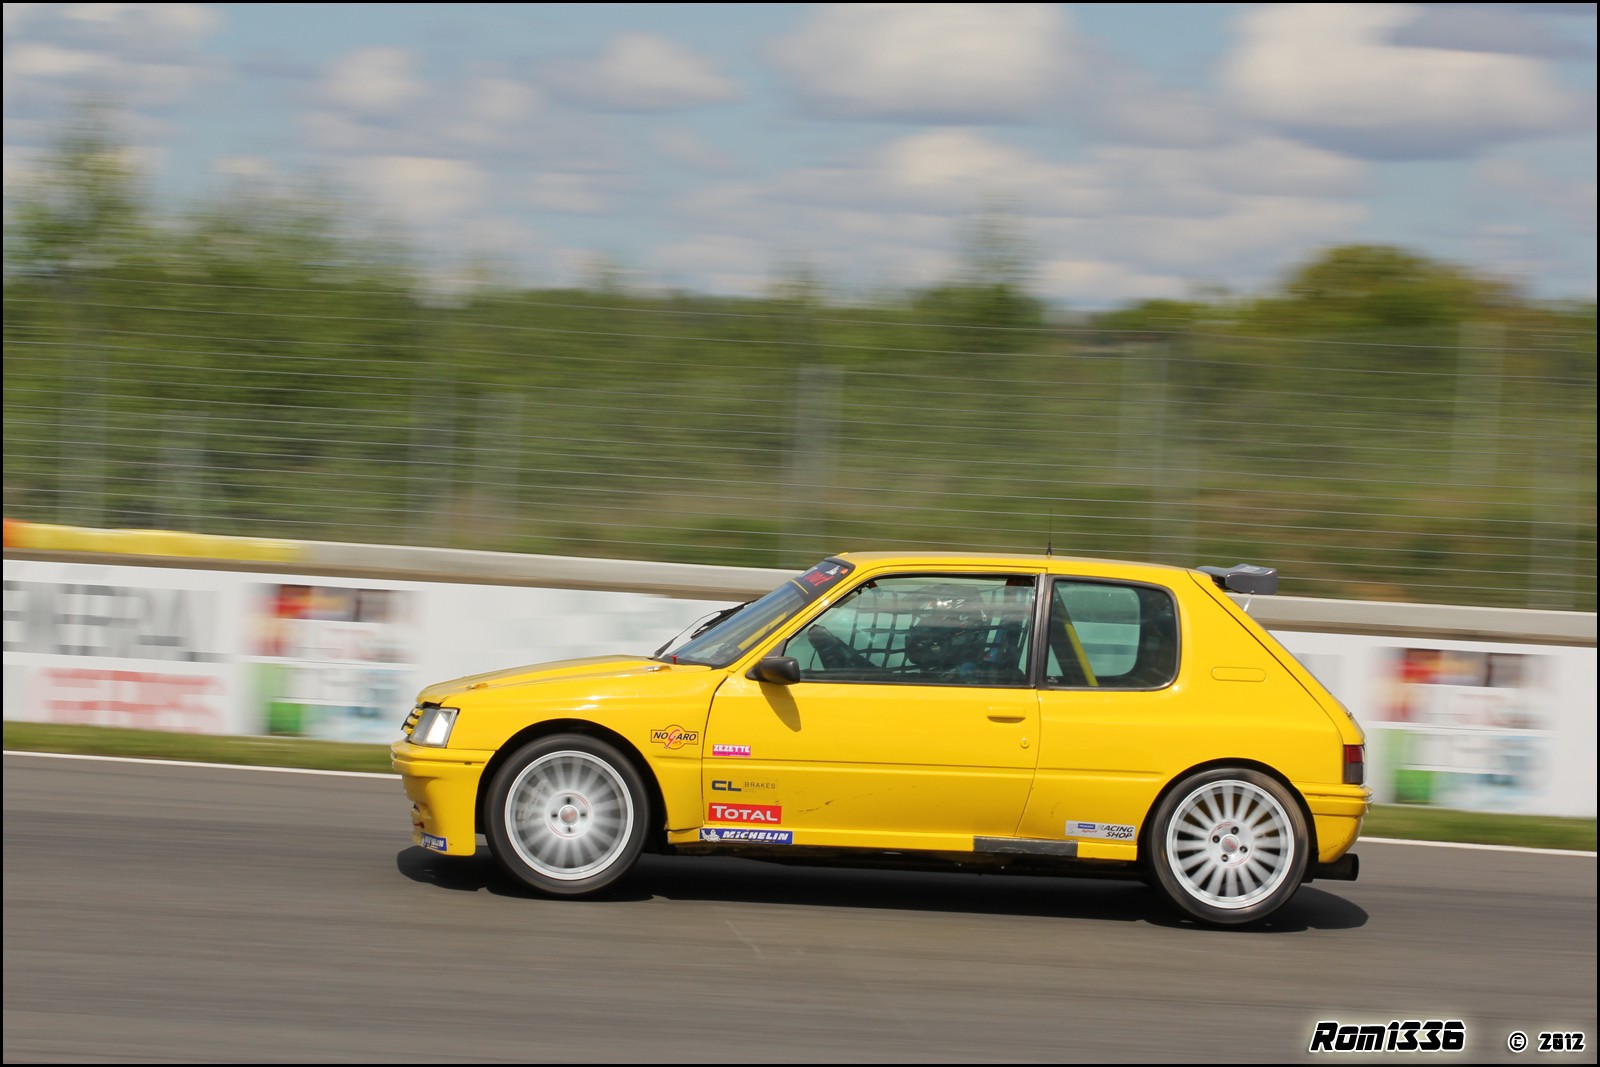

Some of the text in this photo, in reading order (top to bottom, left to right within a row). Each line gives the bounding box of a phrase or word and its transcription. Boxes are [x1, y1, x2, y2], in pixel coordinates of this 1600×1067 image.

[653, 729, 697, 748] NOGARO
[713, 744, 751, 753] ZEZETTE
[711, 780, 742, 792] CL
[711, 805, 778, 822] TOTAL
[1098, 825, 1133, 833] RACING
[722, 830, 789, 841] MICHELIN
